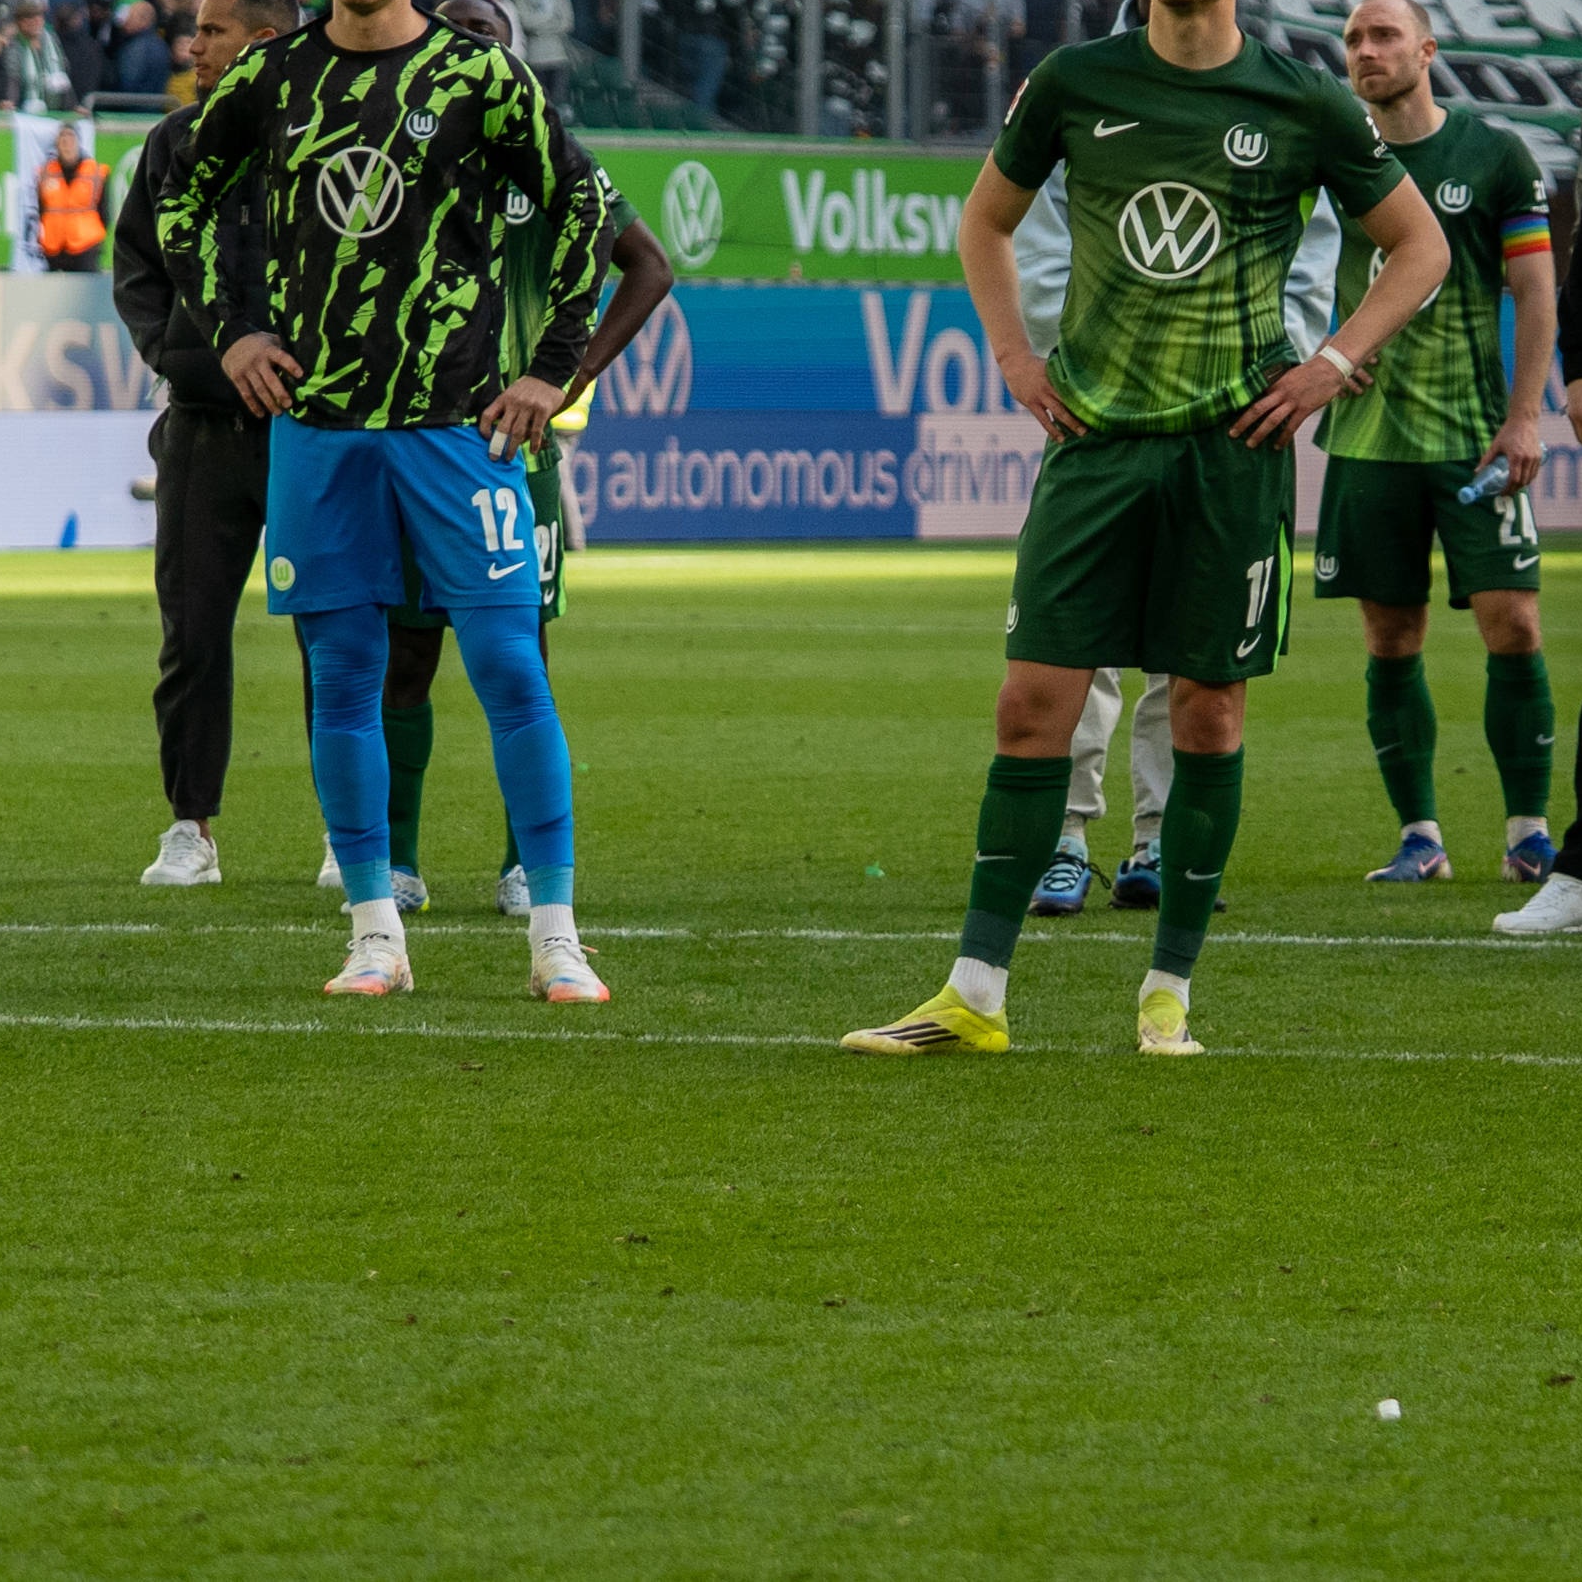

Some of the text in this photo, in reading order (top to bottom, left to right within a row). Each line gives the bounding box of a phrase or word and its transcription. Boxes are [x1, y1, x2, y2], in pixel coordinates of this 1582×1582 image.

[605, 435, 898, 510] autonomous
[902, 426, 1044, 504] drivin
[471, 487, 524, 552] 12
[1494, 492, 1538, 546] 24
